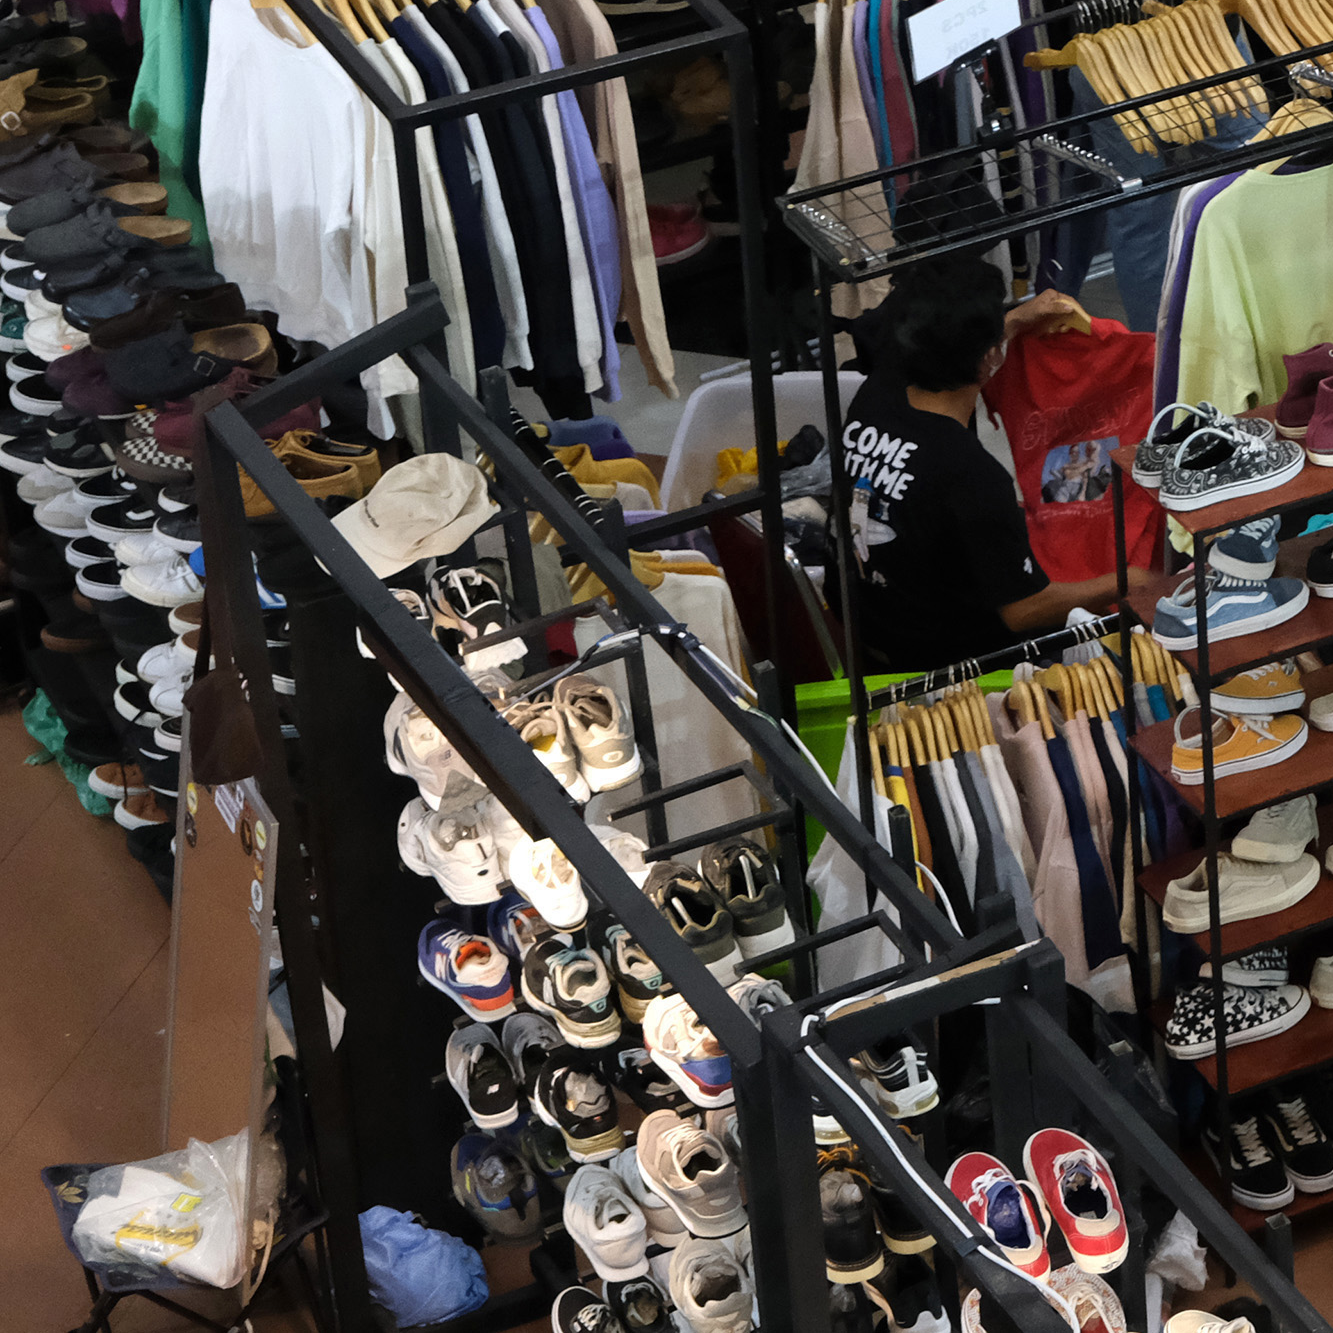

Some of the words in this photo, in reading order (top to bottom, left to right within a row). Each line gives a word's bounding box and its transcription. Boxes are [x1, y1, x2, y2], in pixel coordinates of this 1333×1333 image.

[842, 420, 919, 469] COME
[843, 450, 879, 481] ITH
[873, 465, 915, 501] ME
